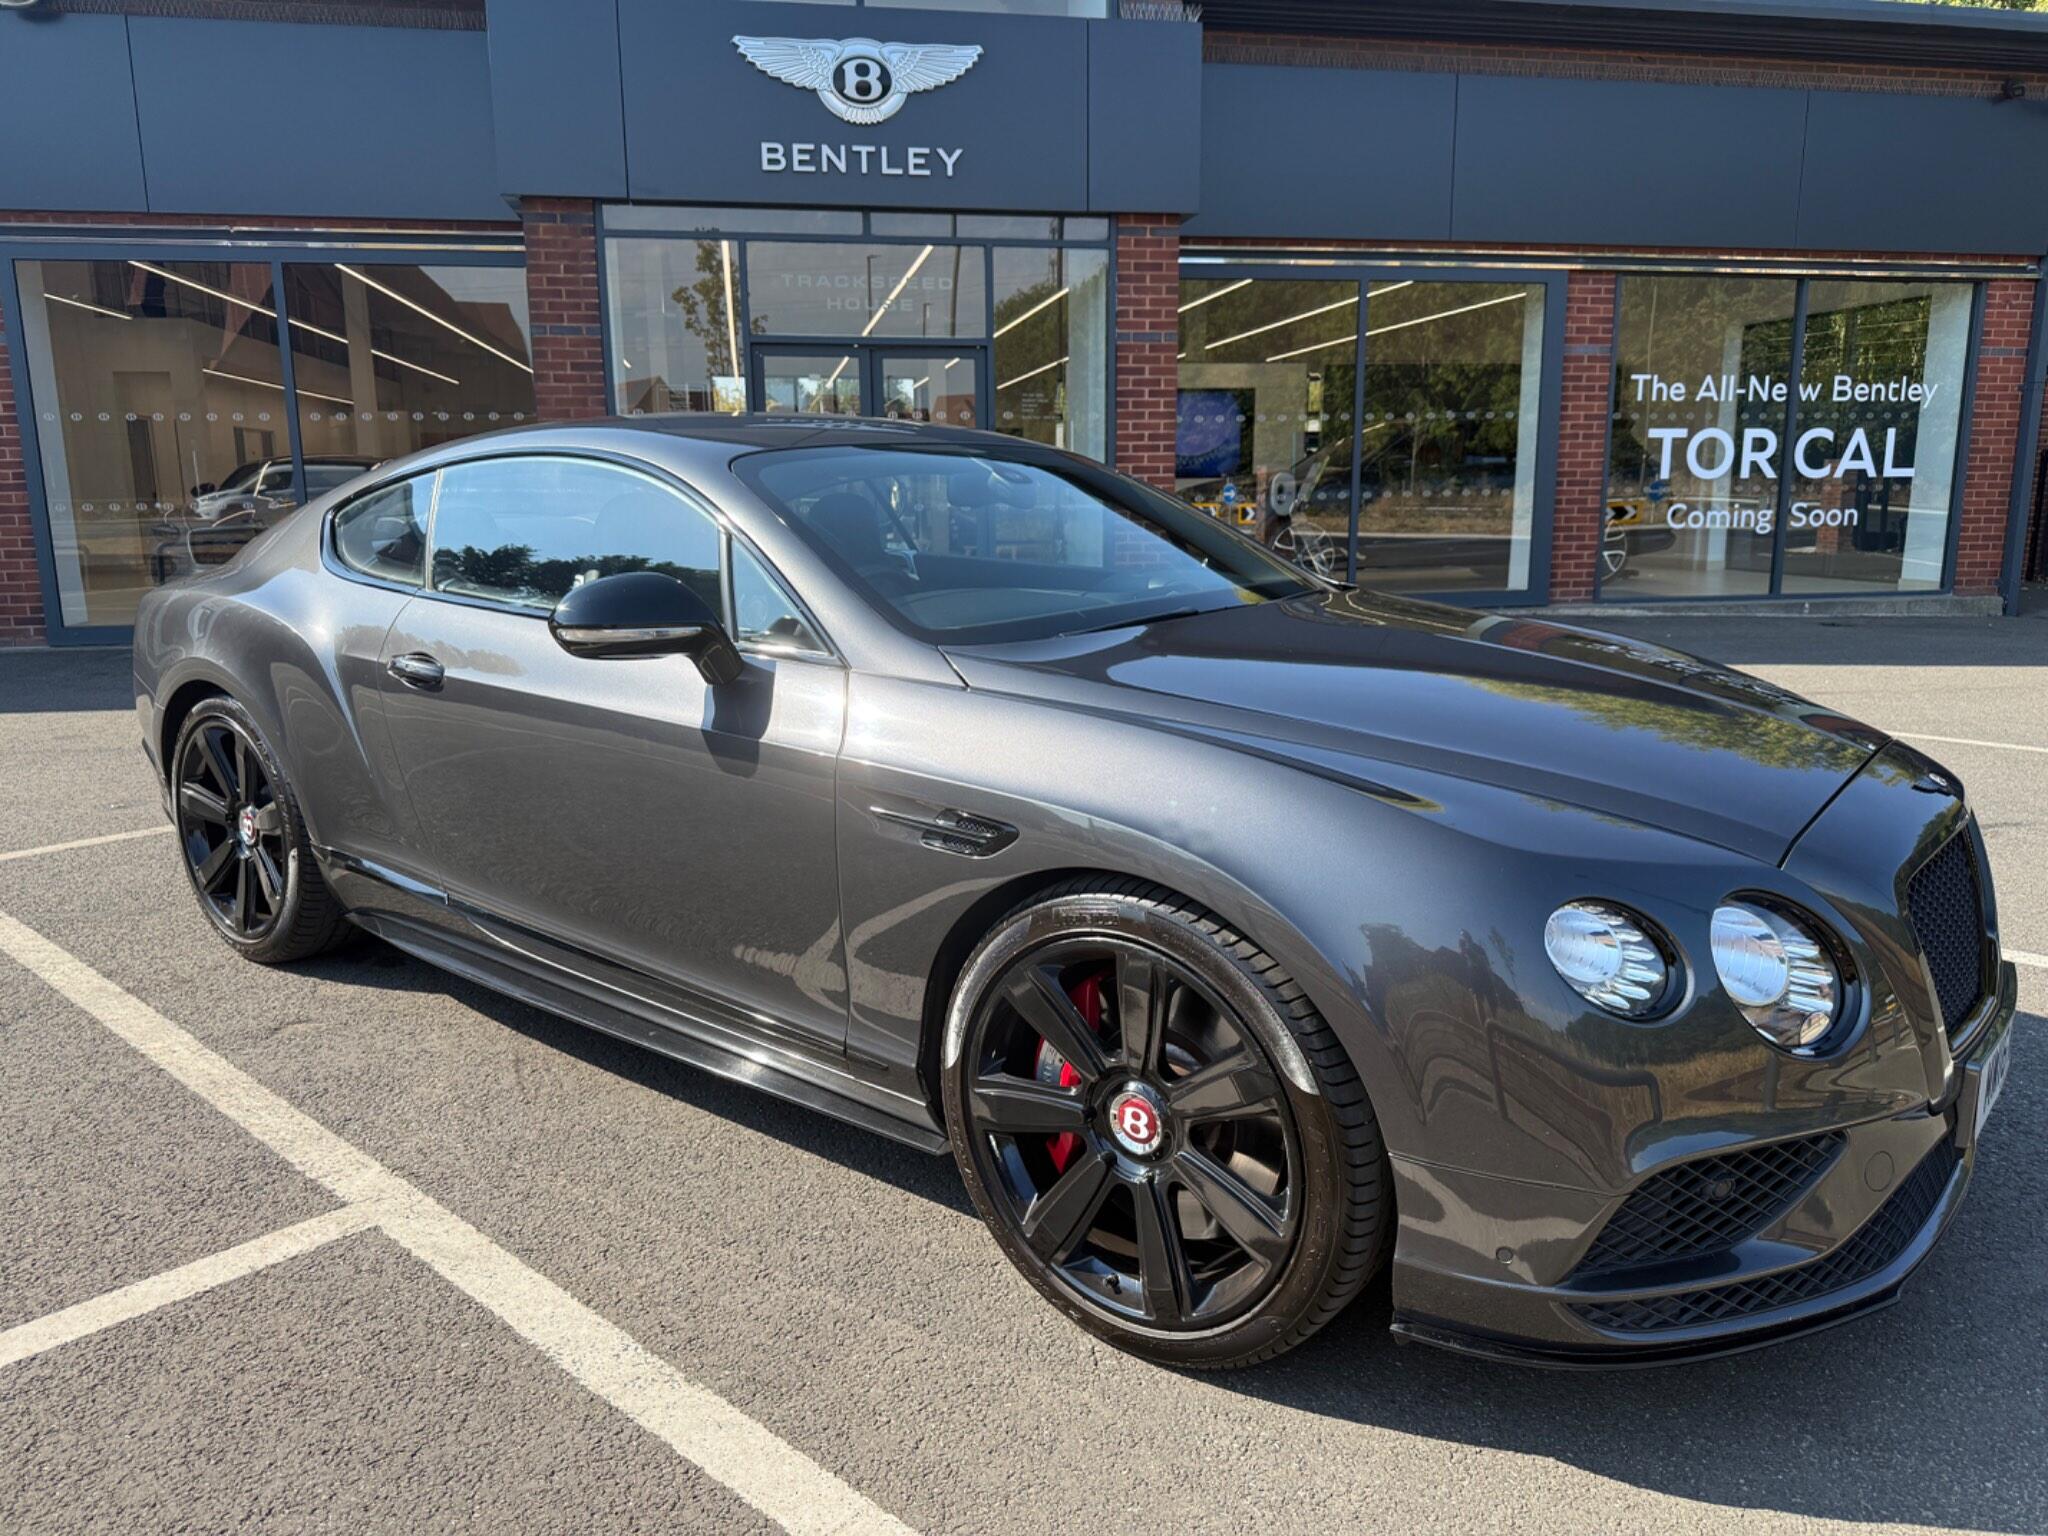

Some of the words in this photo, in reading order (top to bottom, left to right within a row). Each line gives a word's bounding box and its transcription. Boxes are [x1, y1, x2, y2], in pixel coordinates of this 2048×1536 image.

[760, 141, 964, 177] BENTLEY
[1631, 374, 1686, 401] The
[1832, 375, 1939, 408] Bentley
[1666, 503, 1774, 535] Coming
[1790, 502, 1858, 528] Soon
[1122, 1106, 1150, 1140] B
